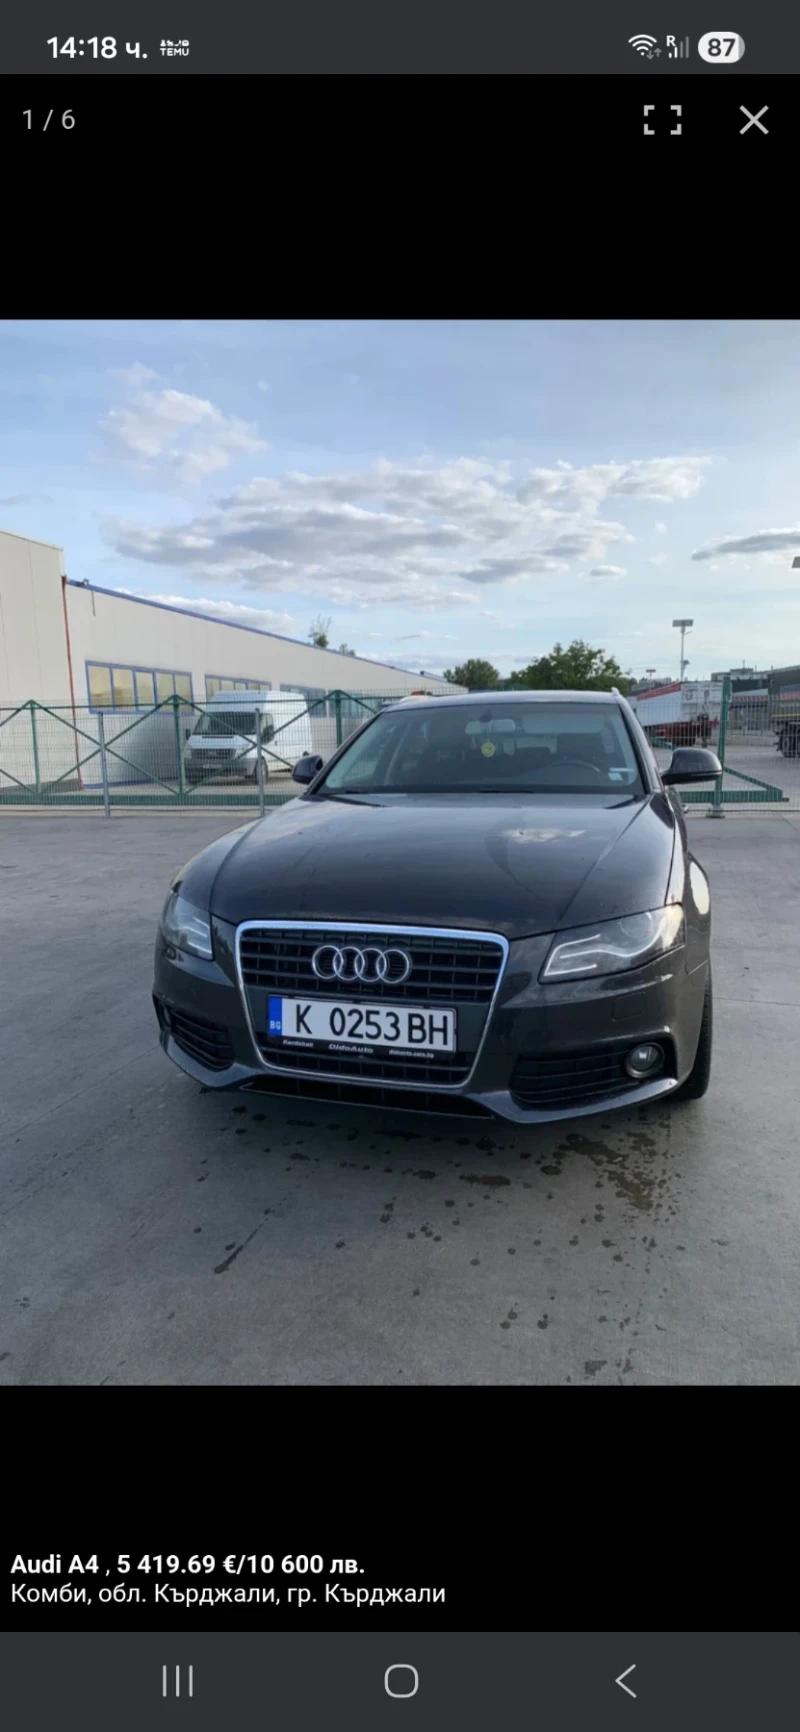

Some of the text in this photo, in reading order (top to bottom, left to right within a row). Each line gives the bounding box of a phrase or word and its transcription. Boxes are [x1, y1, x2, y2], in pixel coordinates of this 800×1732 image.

[269, 1020, 281, 1030] BG
[296, 1004, 448, 1046] K 0253 BH
[328, 1043, 374, 1054] DidoAuto
